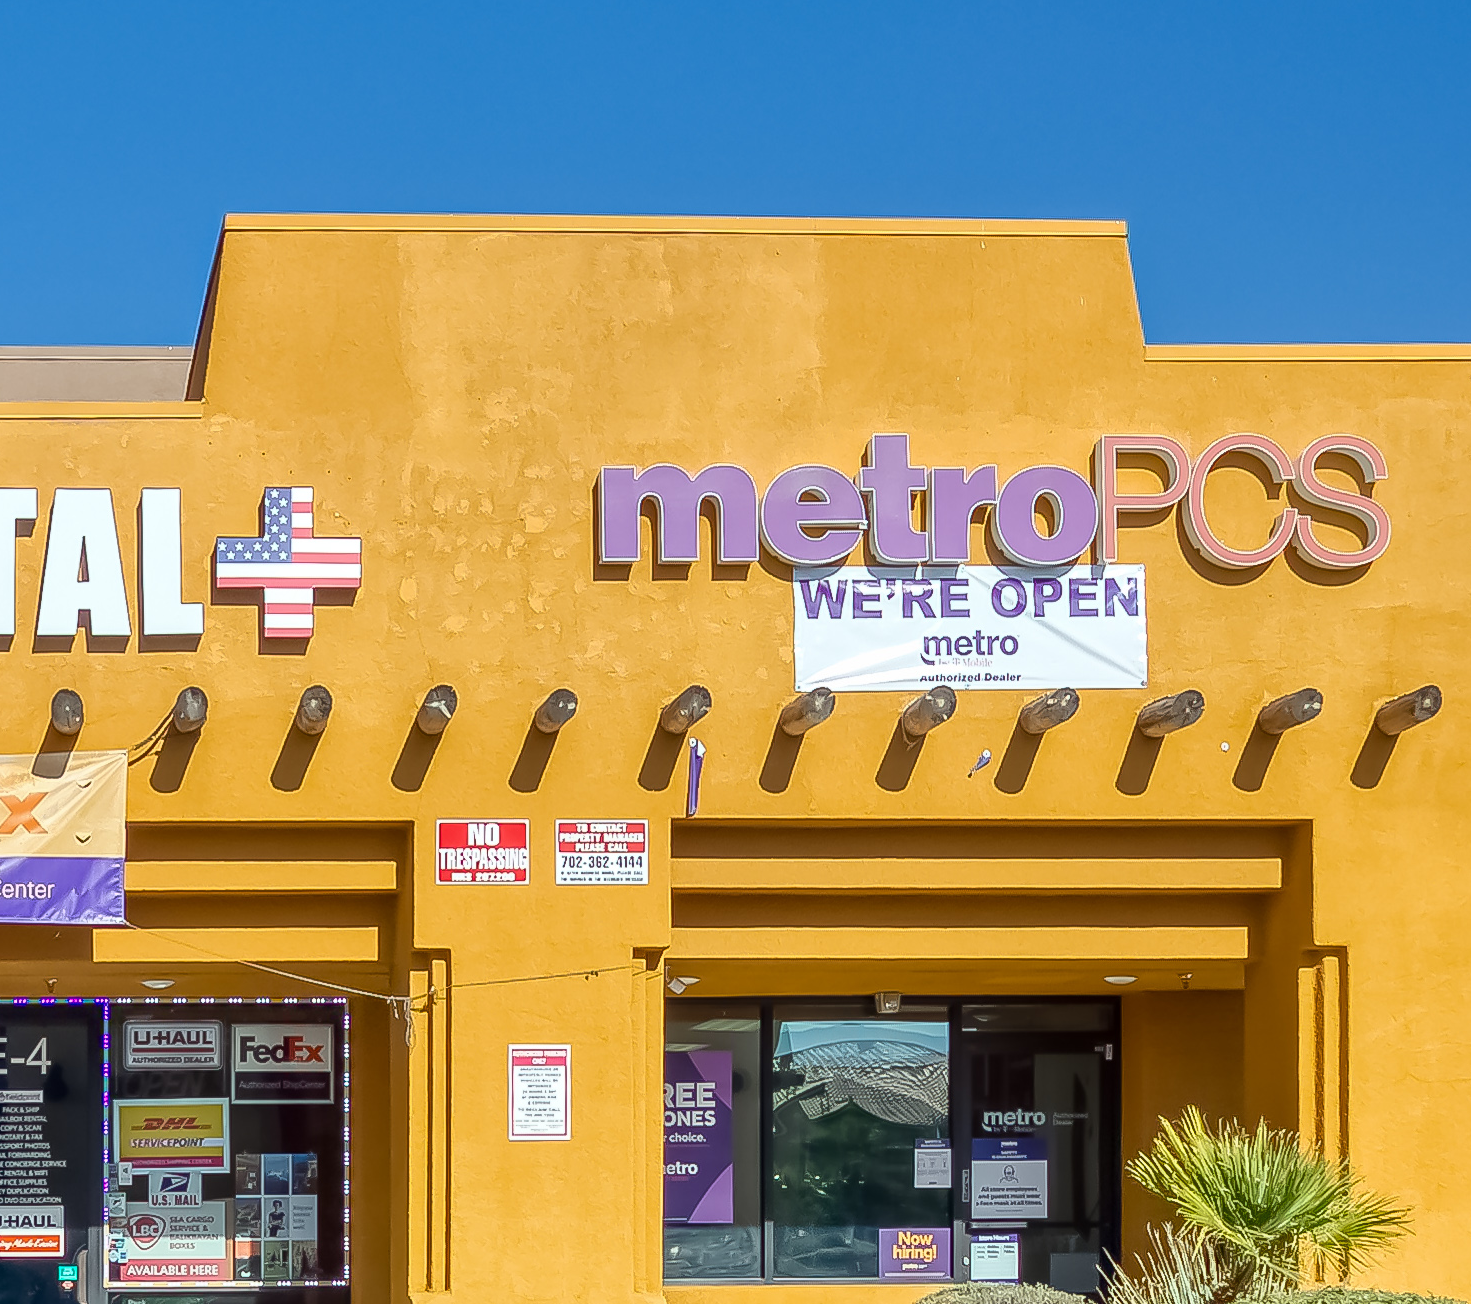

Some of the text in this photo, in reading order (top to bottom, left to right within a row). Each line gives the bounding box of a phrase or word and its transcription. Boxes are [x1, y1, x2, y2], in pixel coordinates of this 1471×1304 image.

[598, 432, 1391, 569] metroPCS
[799, 576, 1140, 619] WE'RE OPEN
[922, 630, 1020, 657] metro
[920, 672, 1022, 683] Authorized Dealer
[467, 822, 500, 847] NO
[559, 832, 602, 843] PROPERTY
[575, 842, 629, 852] PLEASE CALL
[438, 847, 528, 870] TRESPASSING
[561, 855, 643, 869] 702-362-4144
[239, 1035, 325, 1064] FedEx
[131, 1056, 215, 1064] AUTHORIZED DEALER
[238, 1080, 326, 1090] Authorized ShipCenter
[142, 1117, 201, 1130] DHL
[982, 1108, 1046, 1126] metro
[0, 1124, 42, 1132] COPY SCAN
[131, 1137, 205, 1148] SERVICEPOINT
[151, 1194, 200, 1206] U.S. MAIL
[169, 1216, 215, 1224] SEA CARGO
[131, 1223, 160, 1237] LBC
[169, 1224, 200, 1232] SERVICE
[897, 1231, 934, 1246] Now
[169, 1242, 196, 1250] BOXES
[891, 1245, 937, 1263] hiring!
[126, 1264, 219, 1277] AVAILABLE HERE
